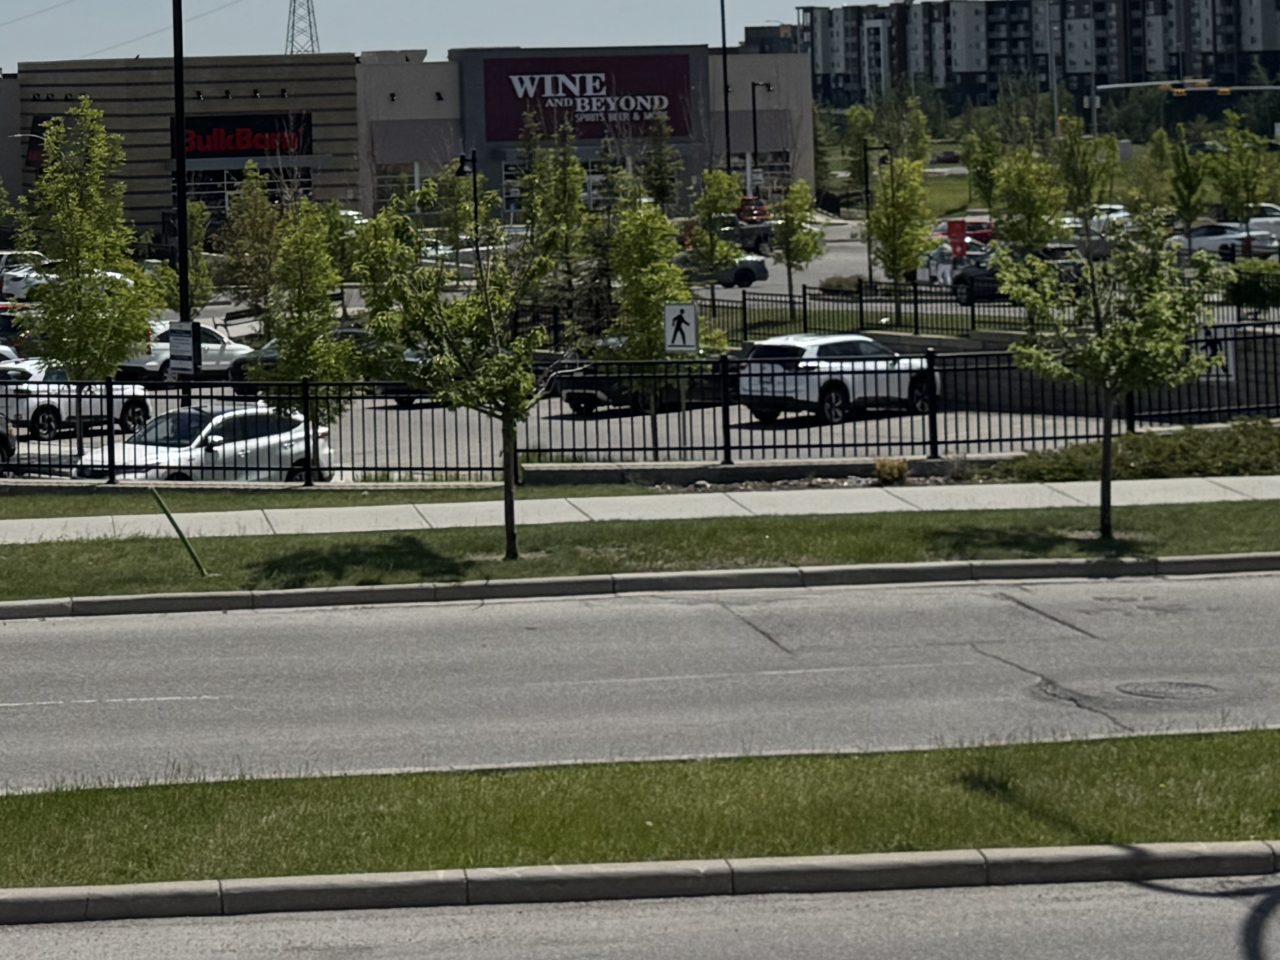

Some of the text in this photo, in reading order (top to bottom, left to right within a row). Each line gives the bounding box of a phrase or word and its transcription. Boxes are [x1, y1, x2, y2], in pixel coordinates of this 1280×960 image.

[508, 73, 607, 99] WINE
[545, 95, 670, 114] AND BEYOND
